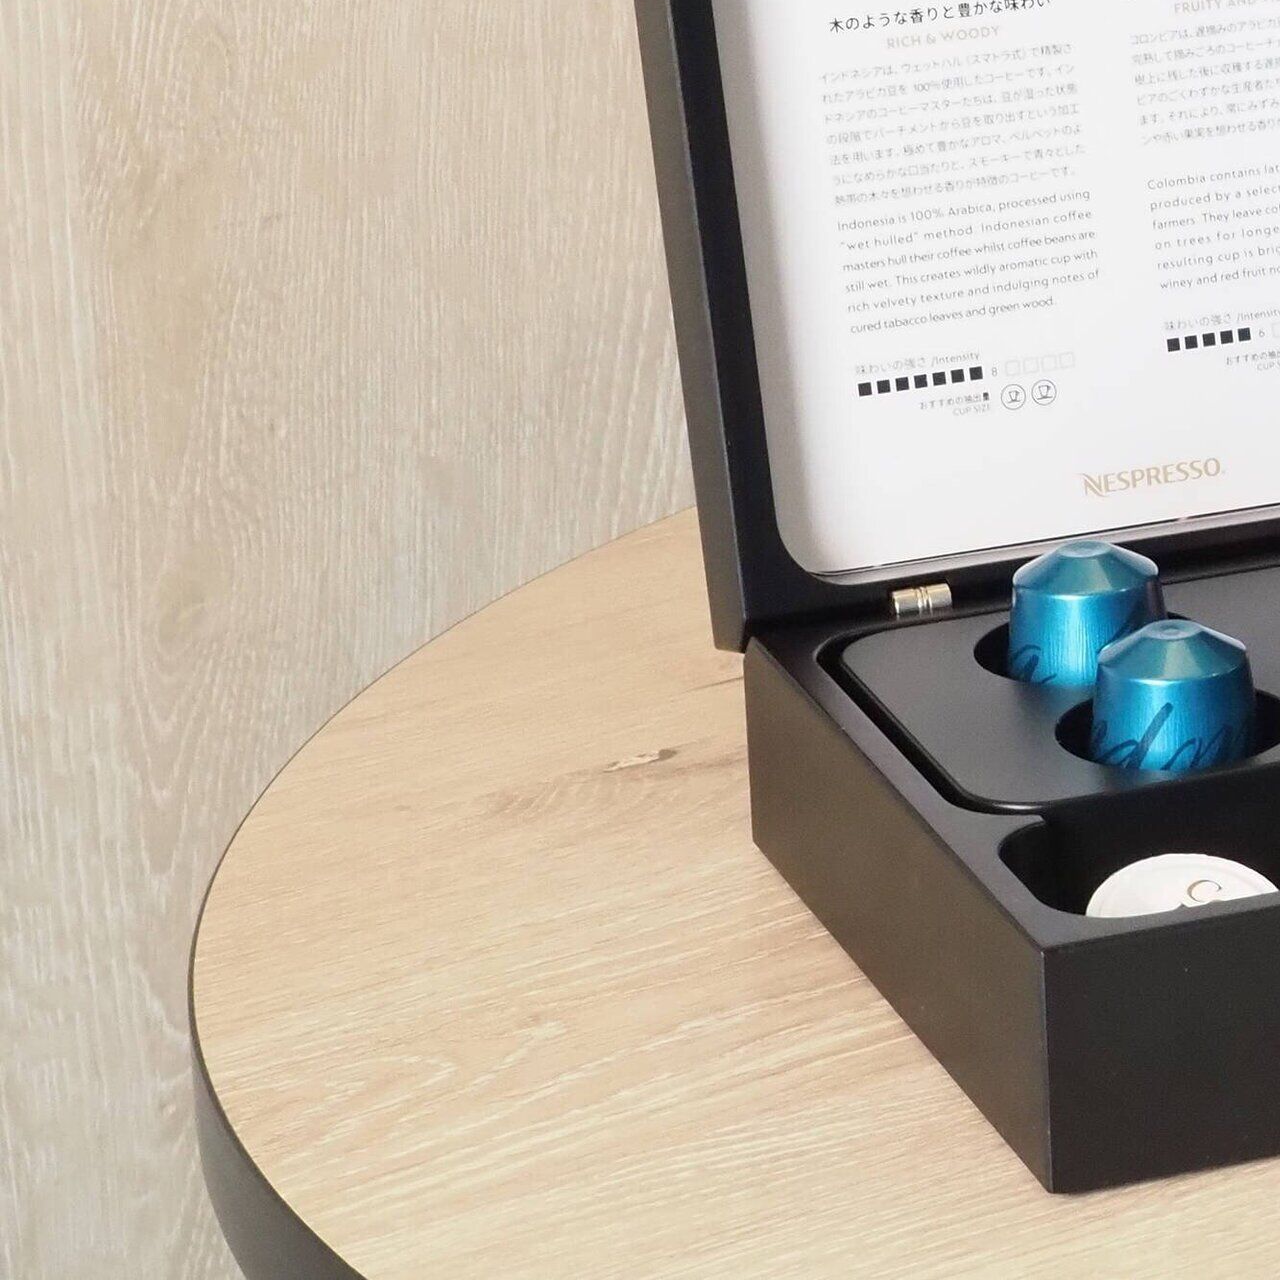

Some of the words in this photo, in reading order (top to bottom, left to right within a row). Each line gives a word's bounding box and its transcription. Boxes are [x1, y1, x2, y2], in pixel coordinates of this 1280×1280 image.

[886, 31, 921, 49] RICH
[926, 31, 937, 45] &
[942, 24, 1001, 42] WOODY
[1146, 174, 1208, 190] Colombia
[1209, 167, 1261, 181] contains
[837, 215, 897, 232] Indonesia
[897, 214, 907, 223] is
[947, 203, 996, 216] Arabica,
[998, 192, 1057, 213] processed
[1059, 190, 1091, 202] using
[1149, 191, 1211, 212] produced
[1214, 190, 1232, 202] by
[1234, 190, 1242, 199] a
[980, 215, 1050, 233] Indonesian
[1052, 209, 1092, 224] coffee
[1201, 210, 1231, 224] They
[1232, 207, 1263, 219] leave
[842, 258, 887, 272] masters
[886, 253, 908, 265] hull
[908, 248, 934, 264] their
[936, 245, 974, 261] coffee
[973, 239, 1007, 256] whilst
[1007, 236, 1044, 250] coffee
[1043, 231, 1078, 248] beans
[1077, 231, 1096, 240] are
[1154, 240, 1173, 250] on
[1176, 235, 1212, 248] trees
[1216, 230, 1237, 240] for
[845, 279, 868, 293] still
[894, 273, 919, 286] This
[919, 268, 964, 283] creates
[961, 263, 997, 279] wildly
[997, 256, 1049, 272] aromatic
[1050, 254, 1072, 266] cup
[1072, 247, 1099, 264] with
[1157, 254, 1214, 271] resulting
[1215, 247, 1243, 263] cup
[1242, 247, 1256, 258] is
[1159, 277, 1194, 289] winey
[1196, 271, 1218, 285] and
[1220, 268, 1242, 282] red
[1242, 263, 1267, 278] fruit
[847, 300, 871, 312] rich
[872, 295, 917, 309] velvety
[919, 289, 965, 303] texture
[967, 282, 991, 297] and
[991, 277, 1052, 294] indulging
[1049, 271, 1086, 286] notes
[1086, 267, 1099, 280] of
[850, 319, 882, 333] cured
[928, 310, 964, 322] leaves
[964, 304, 987, 319] and
[988, 302, 1021, 317] green
[1258, 328, 1266, 338] 6
[991, 366, 999, 377] 8
[1081, 457, 1221, 497] NESPRESSO
